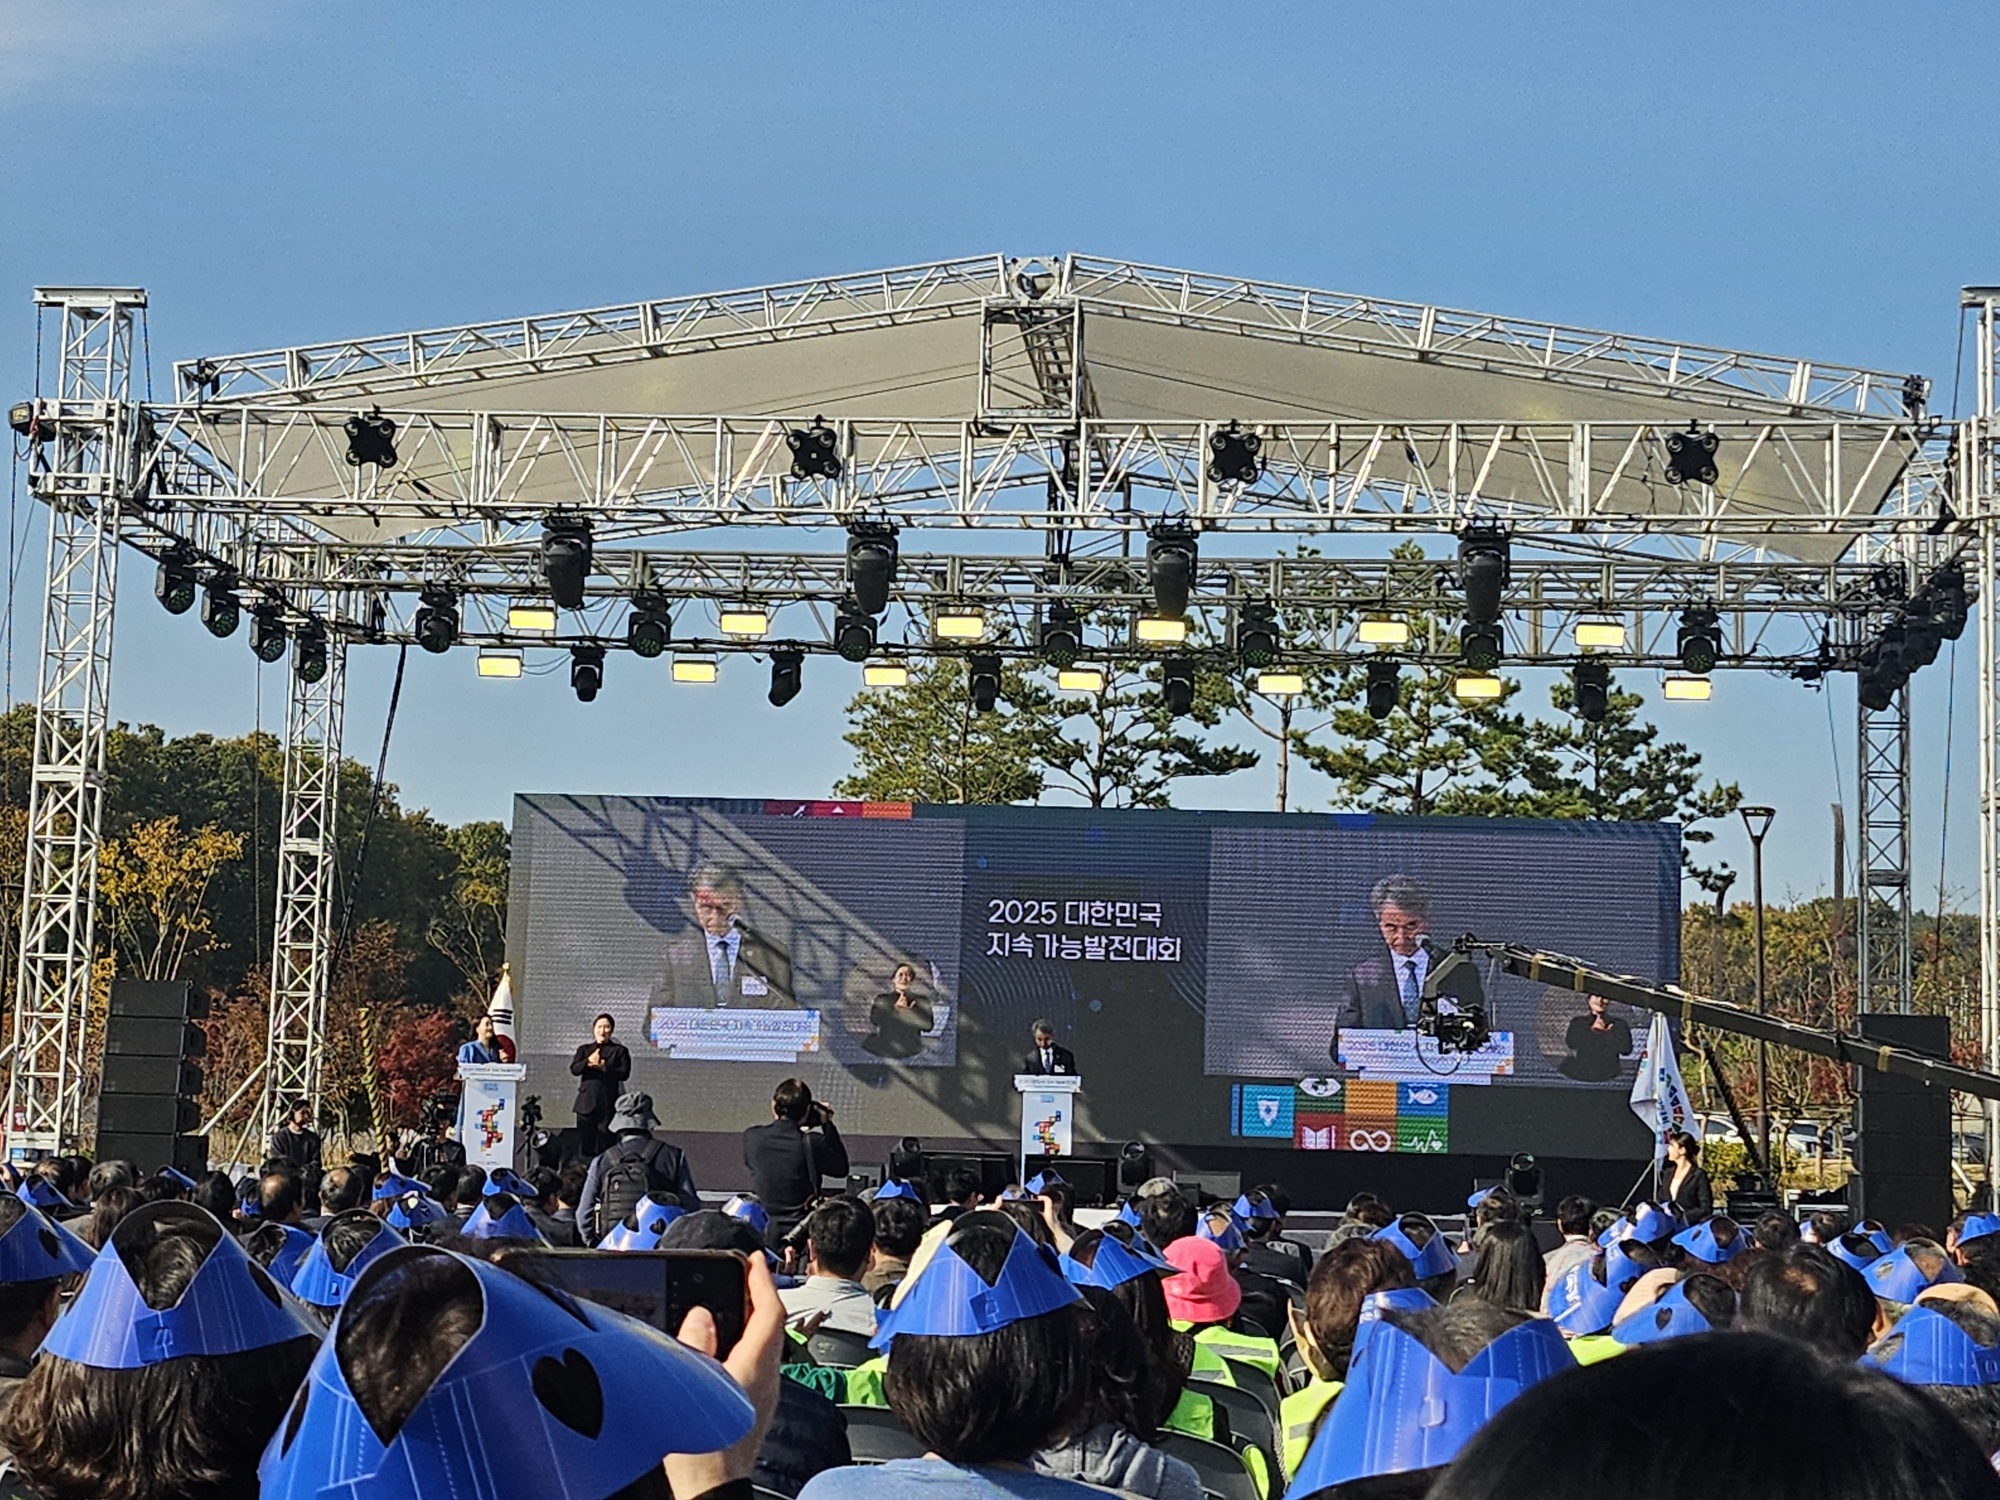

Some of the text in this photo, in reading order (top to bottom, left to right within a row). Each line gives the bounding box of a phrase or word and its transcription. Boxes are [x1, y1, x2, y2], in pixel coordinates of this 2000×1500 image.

[988, 899, 1163, 927] 2025 대한민국
[986, 932, 1181, 962] 지속가능발전대회
